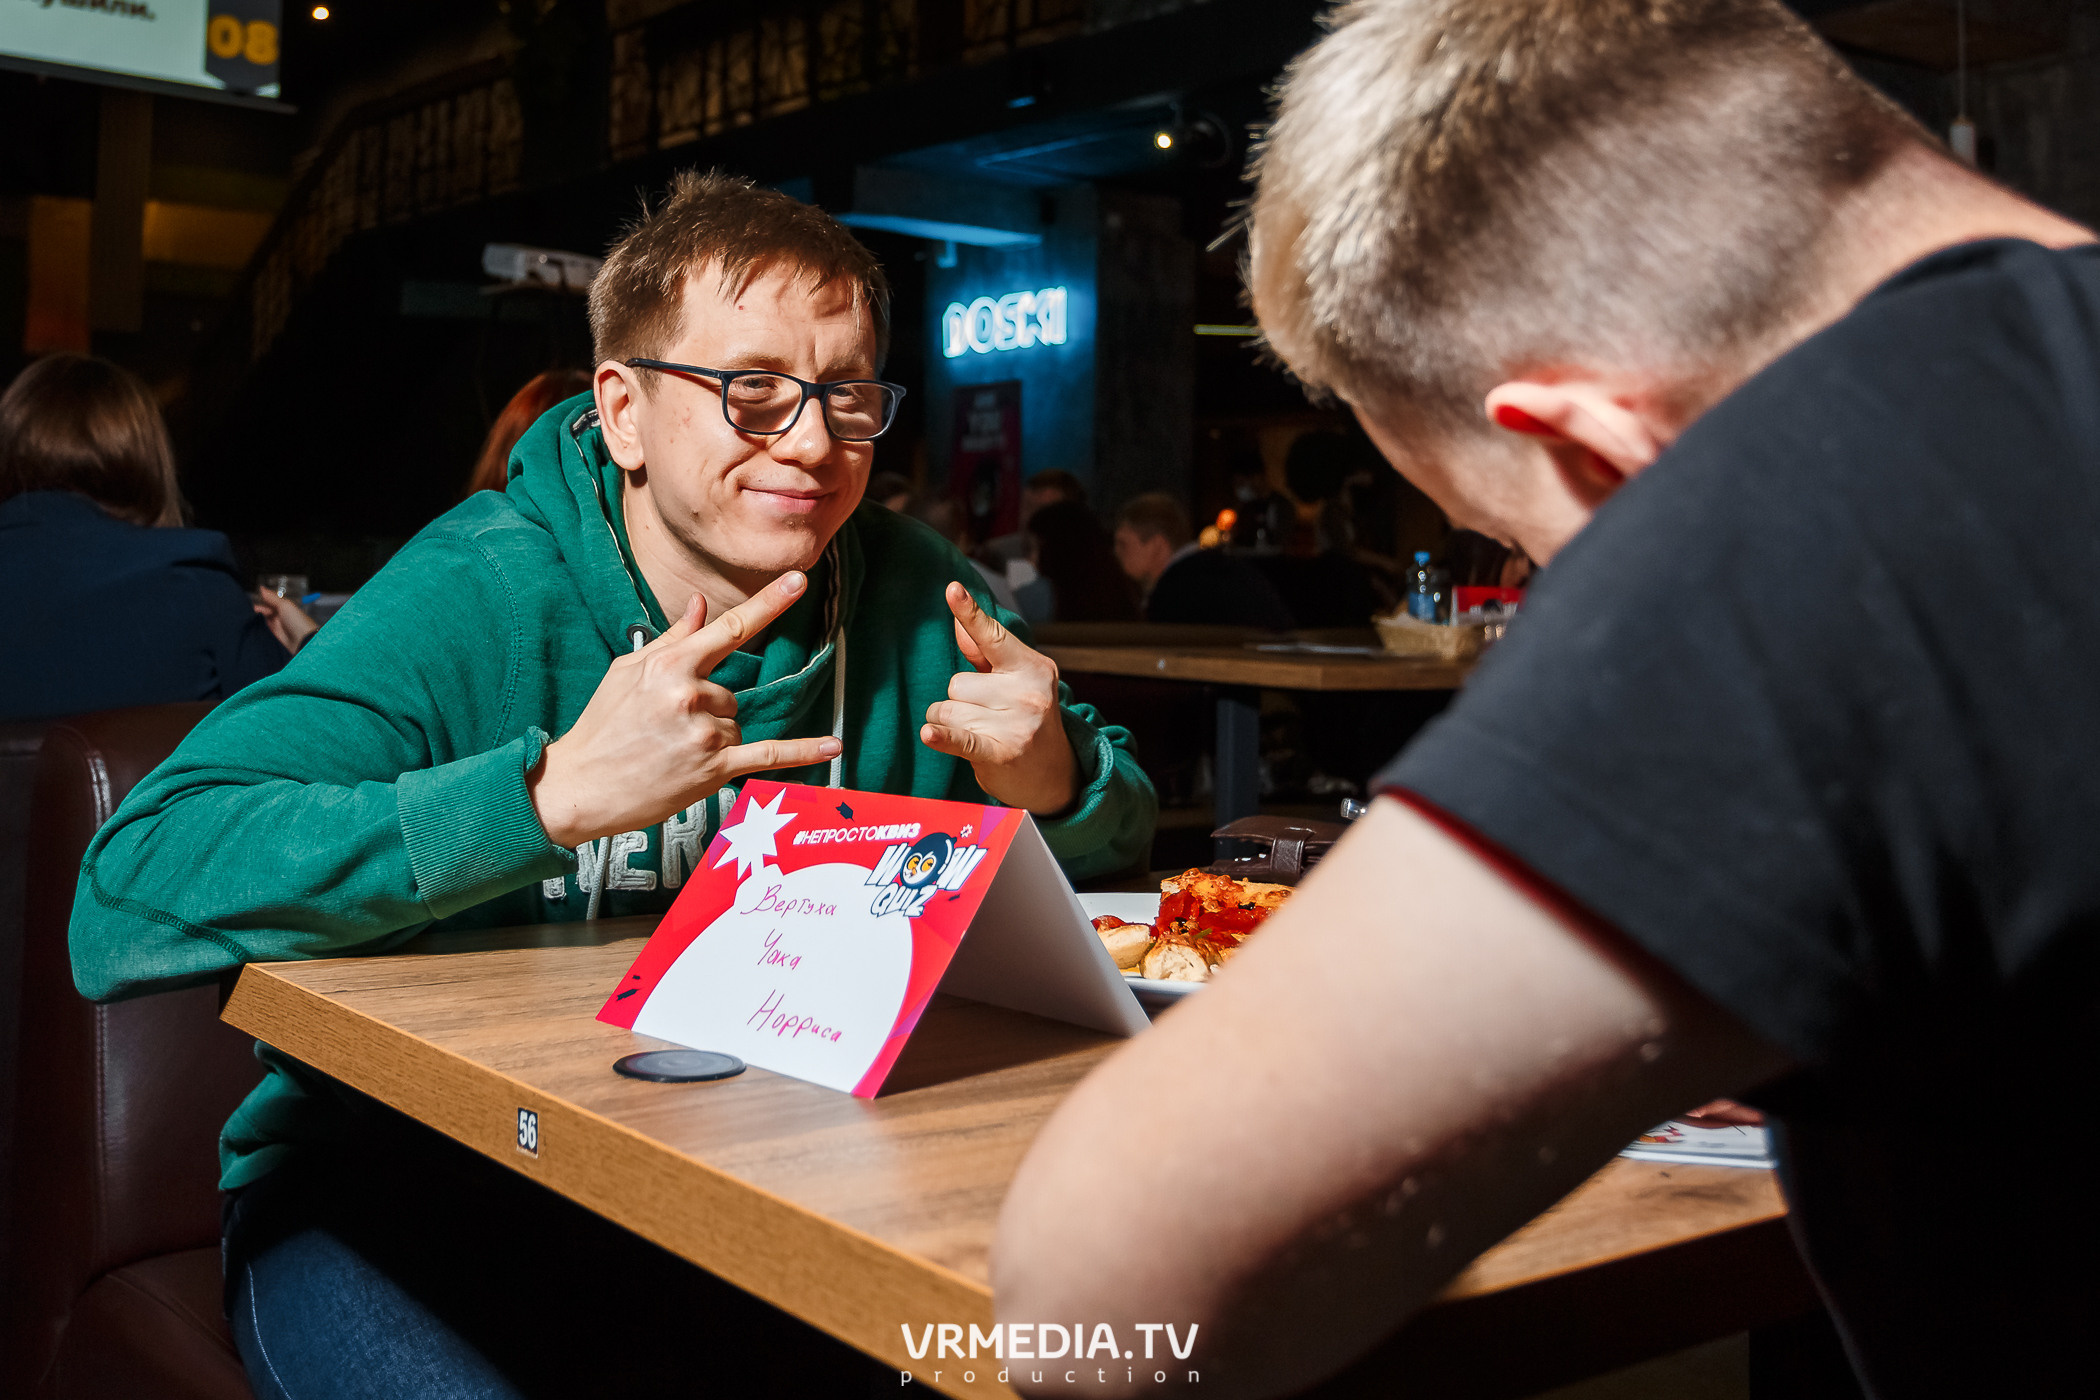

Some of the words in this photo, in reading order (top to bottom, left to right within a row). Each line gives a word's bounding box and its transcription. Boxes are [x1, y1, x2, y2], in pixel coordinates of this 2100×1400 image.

[208, 14, 279, 66] 08
[792, 822, 921, 846] #НЕПРОСТОКВИЗ
[740, 884, 837, 918] Вертуха
[870, 882, 938, 918] QUIZ
[757, 928, 802, 970] Чака
[747, 989, 843, 1043] Норриса
[519, 1110, 537, 1149] 56
